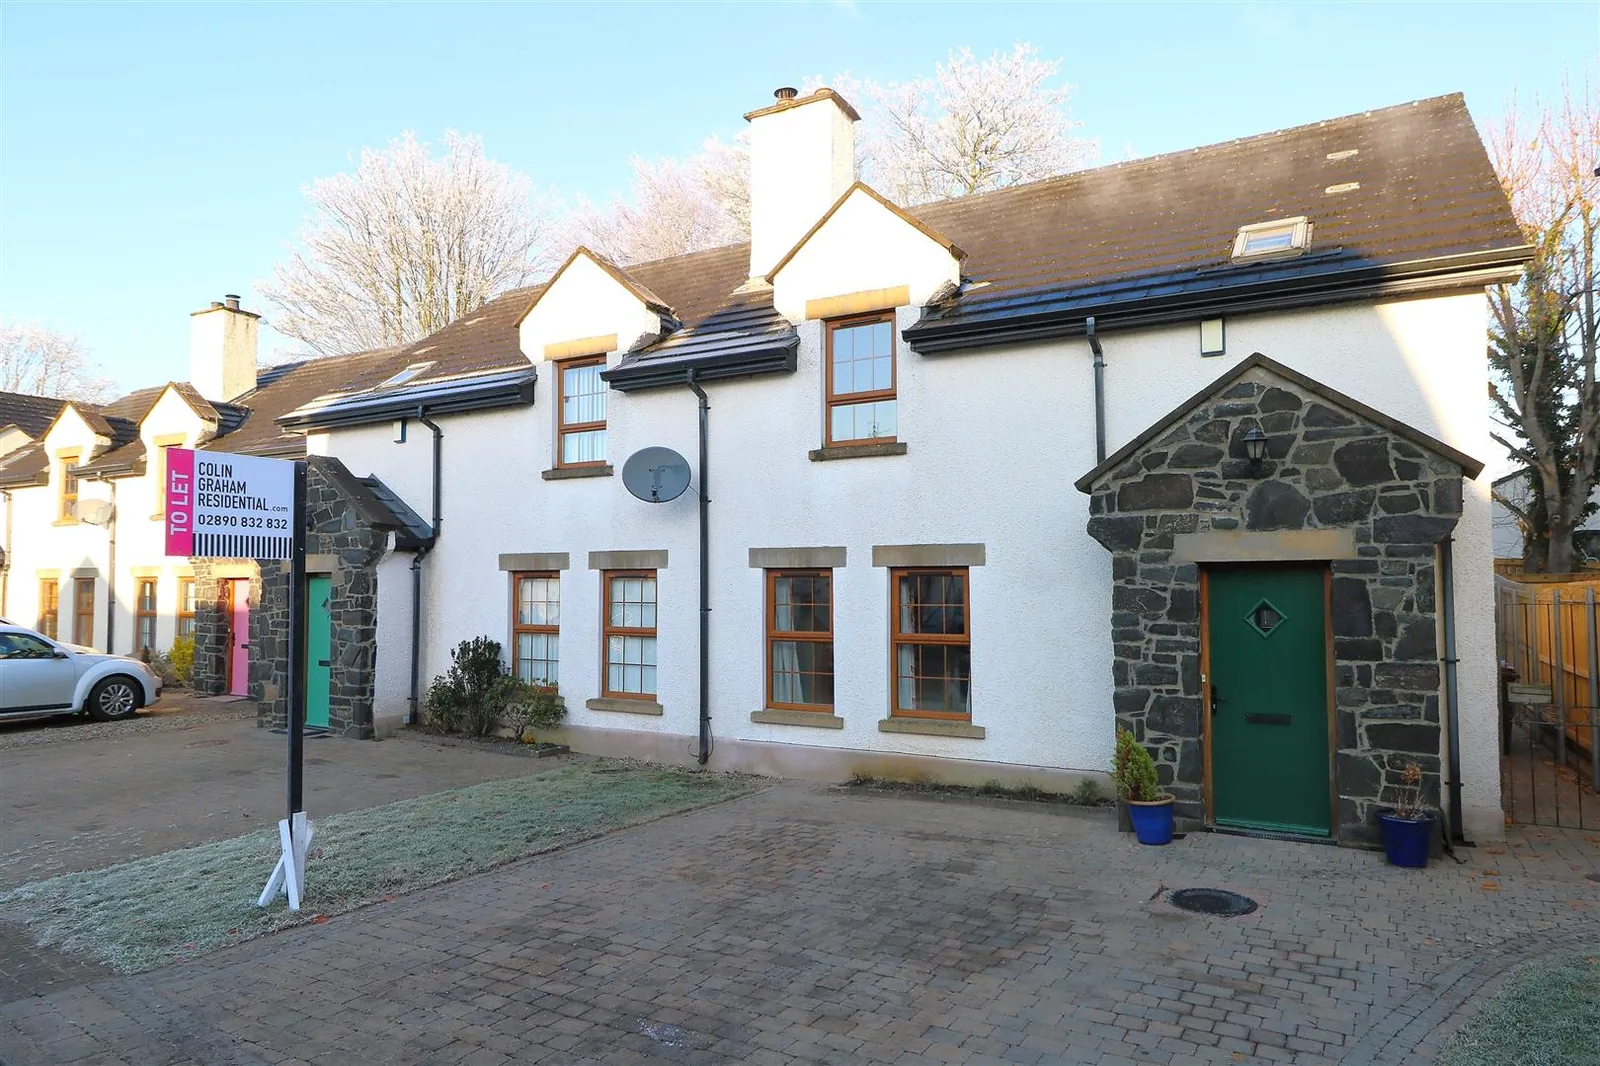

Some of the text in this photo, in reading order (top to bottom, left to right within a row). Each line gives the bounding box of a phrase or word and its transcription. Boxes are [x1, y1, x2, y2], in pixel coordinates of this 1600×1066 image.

[198, 462, 233, 478] COLIN
[198, 478, 246, 494] GRAHAM
[170, 470, 188, 535] TO LET
[198, 514, 288, 529] 02890 832 832
